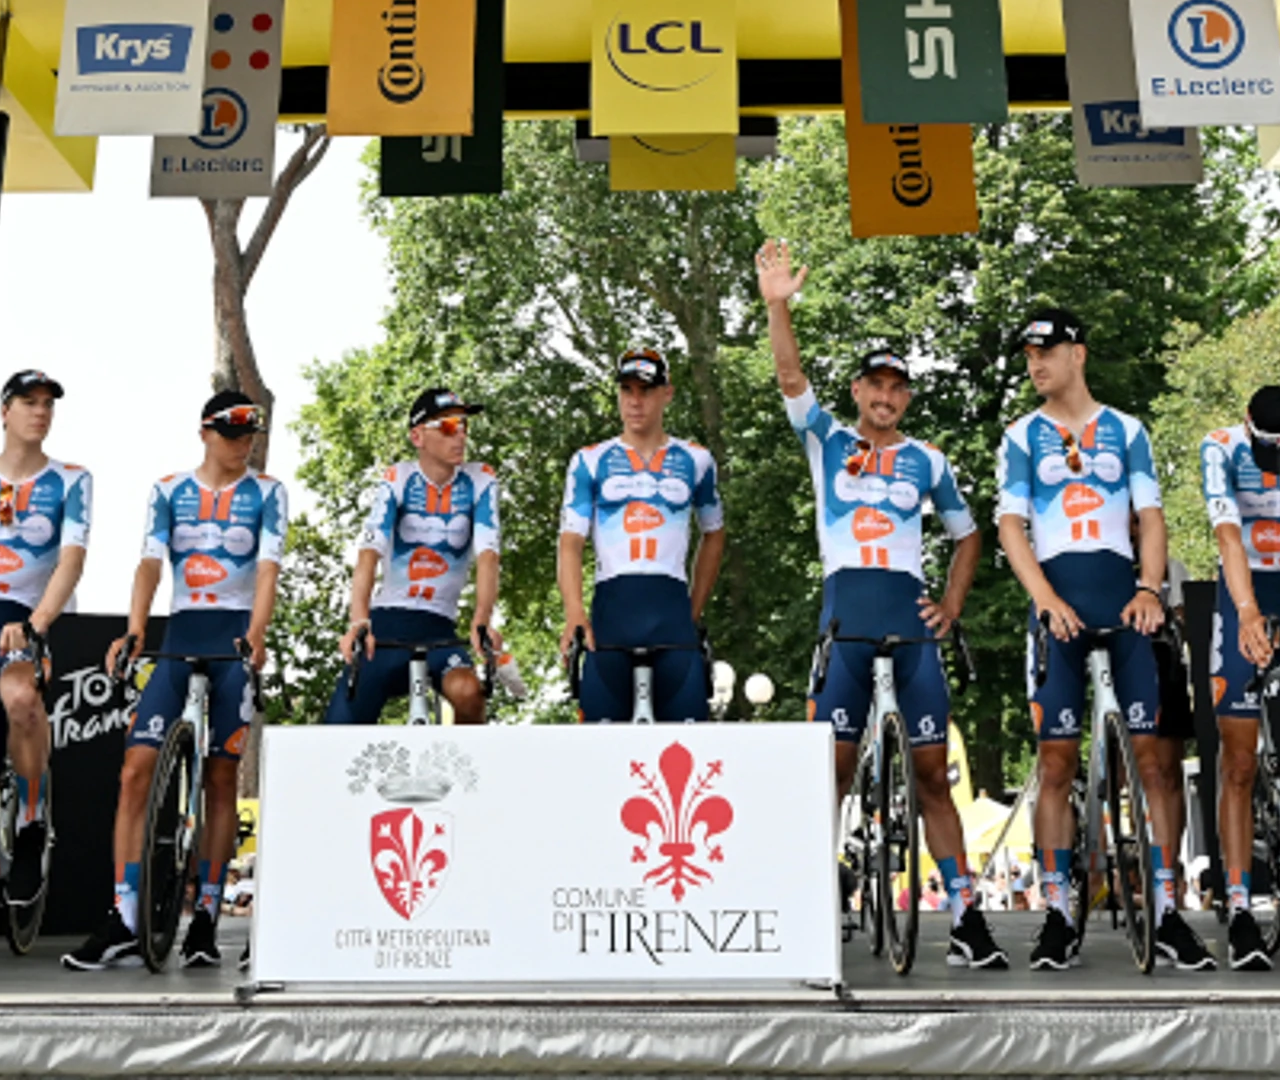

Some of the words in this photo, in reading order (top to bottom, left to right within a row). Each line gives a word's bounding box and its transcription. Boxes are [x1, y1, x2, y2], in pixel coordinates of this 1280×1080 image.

[618, 21, 724, 54] LCL
[95, 32, 172, 67] Krys
[1150, 77, 1275, 98] E.Leclerc
[162, 156, 264, 174] E.Leclerc
[552, 887, 646, 908] COMUNE
[377, 928, 491, 949] METROPOLITANA
[552, 910, 573, 932] DI
[577, 909, 782, 966] FIRENZE
[375, 950, 391, 969] DI
[393, 949, 453, 969] FIRENZE
